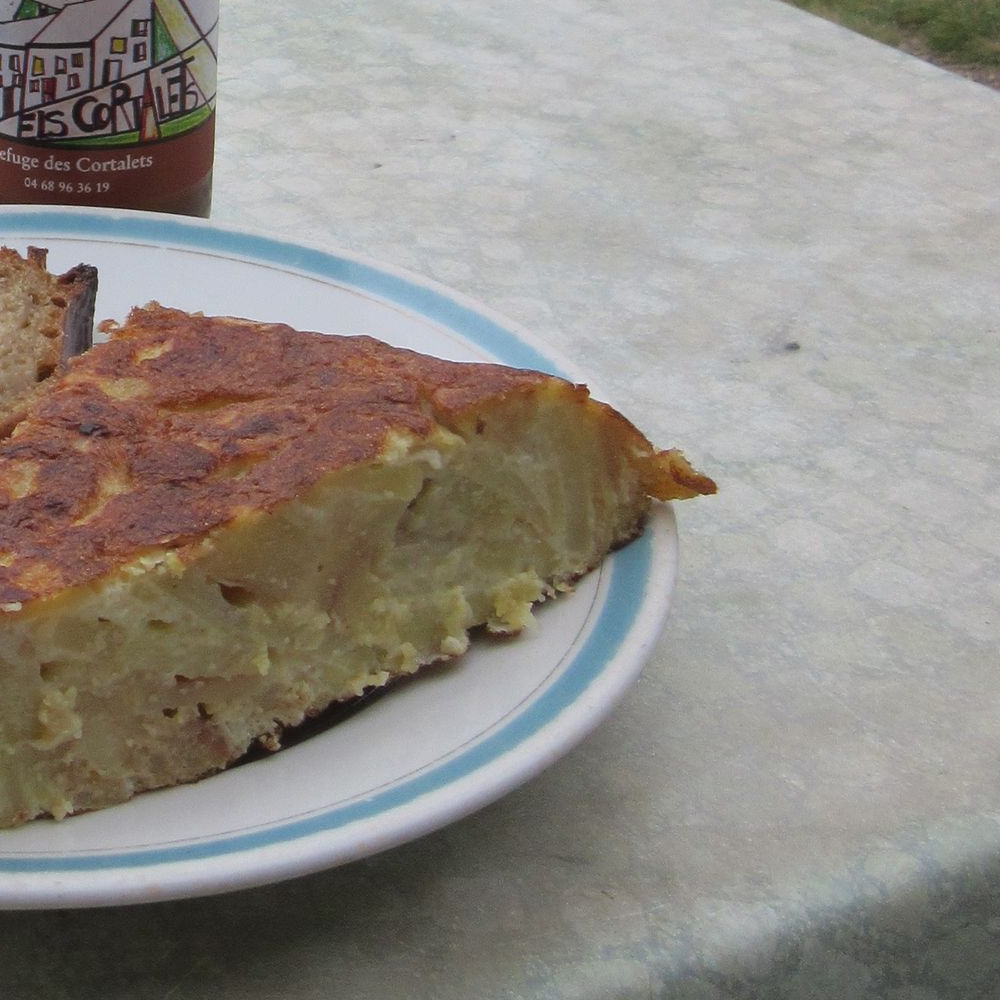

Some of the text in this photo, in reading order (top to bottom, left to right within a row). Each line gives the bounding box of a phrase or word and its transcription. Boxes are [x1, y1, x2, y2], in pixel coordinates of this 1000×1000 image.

[43, 155, 71, 172] des
[76, 154, 153, 173] Cortalets
[23, 177, 110, 193] 04 68 96 36 19
